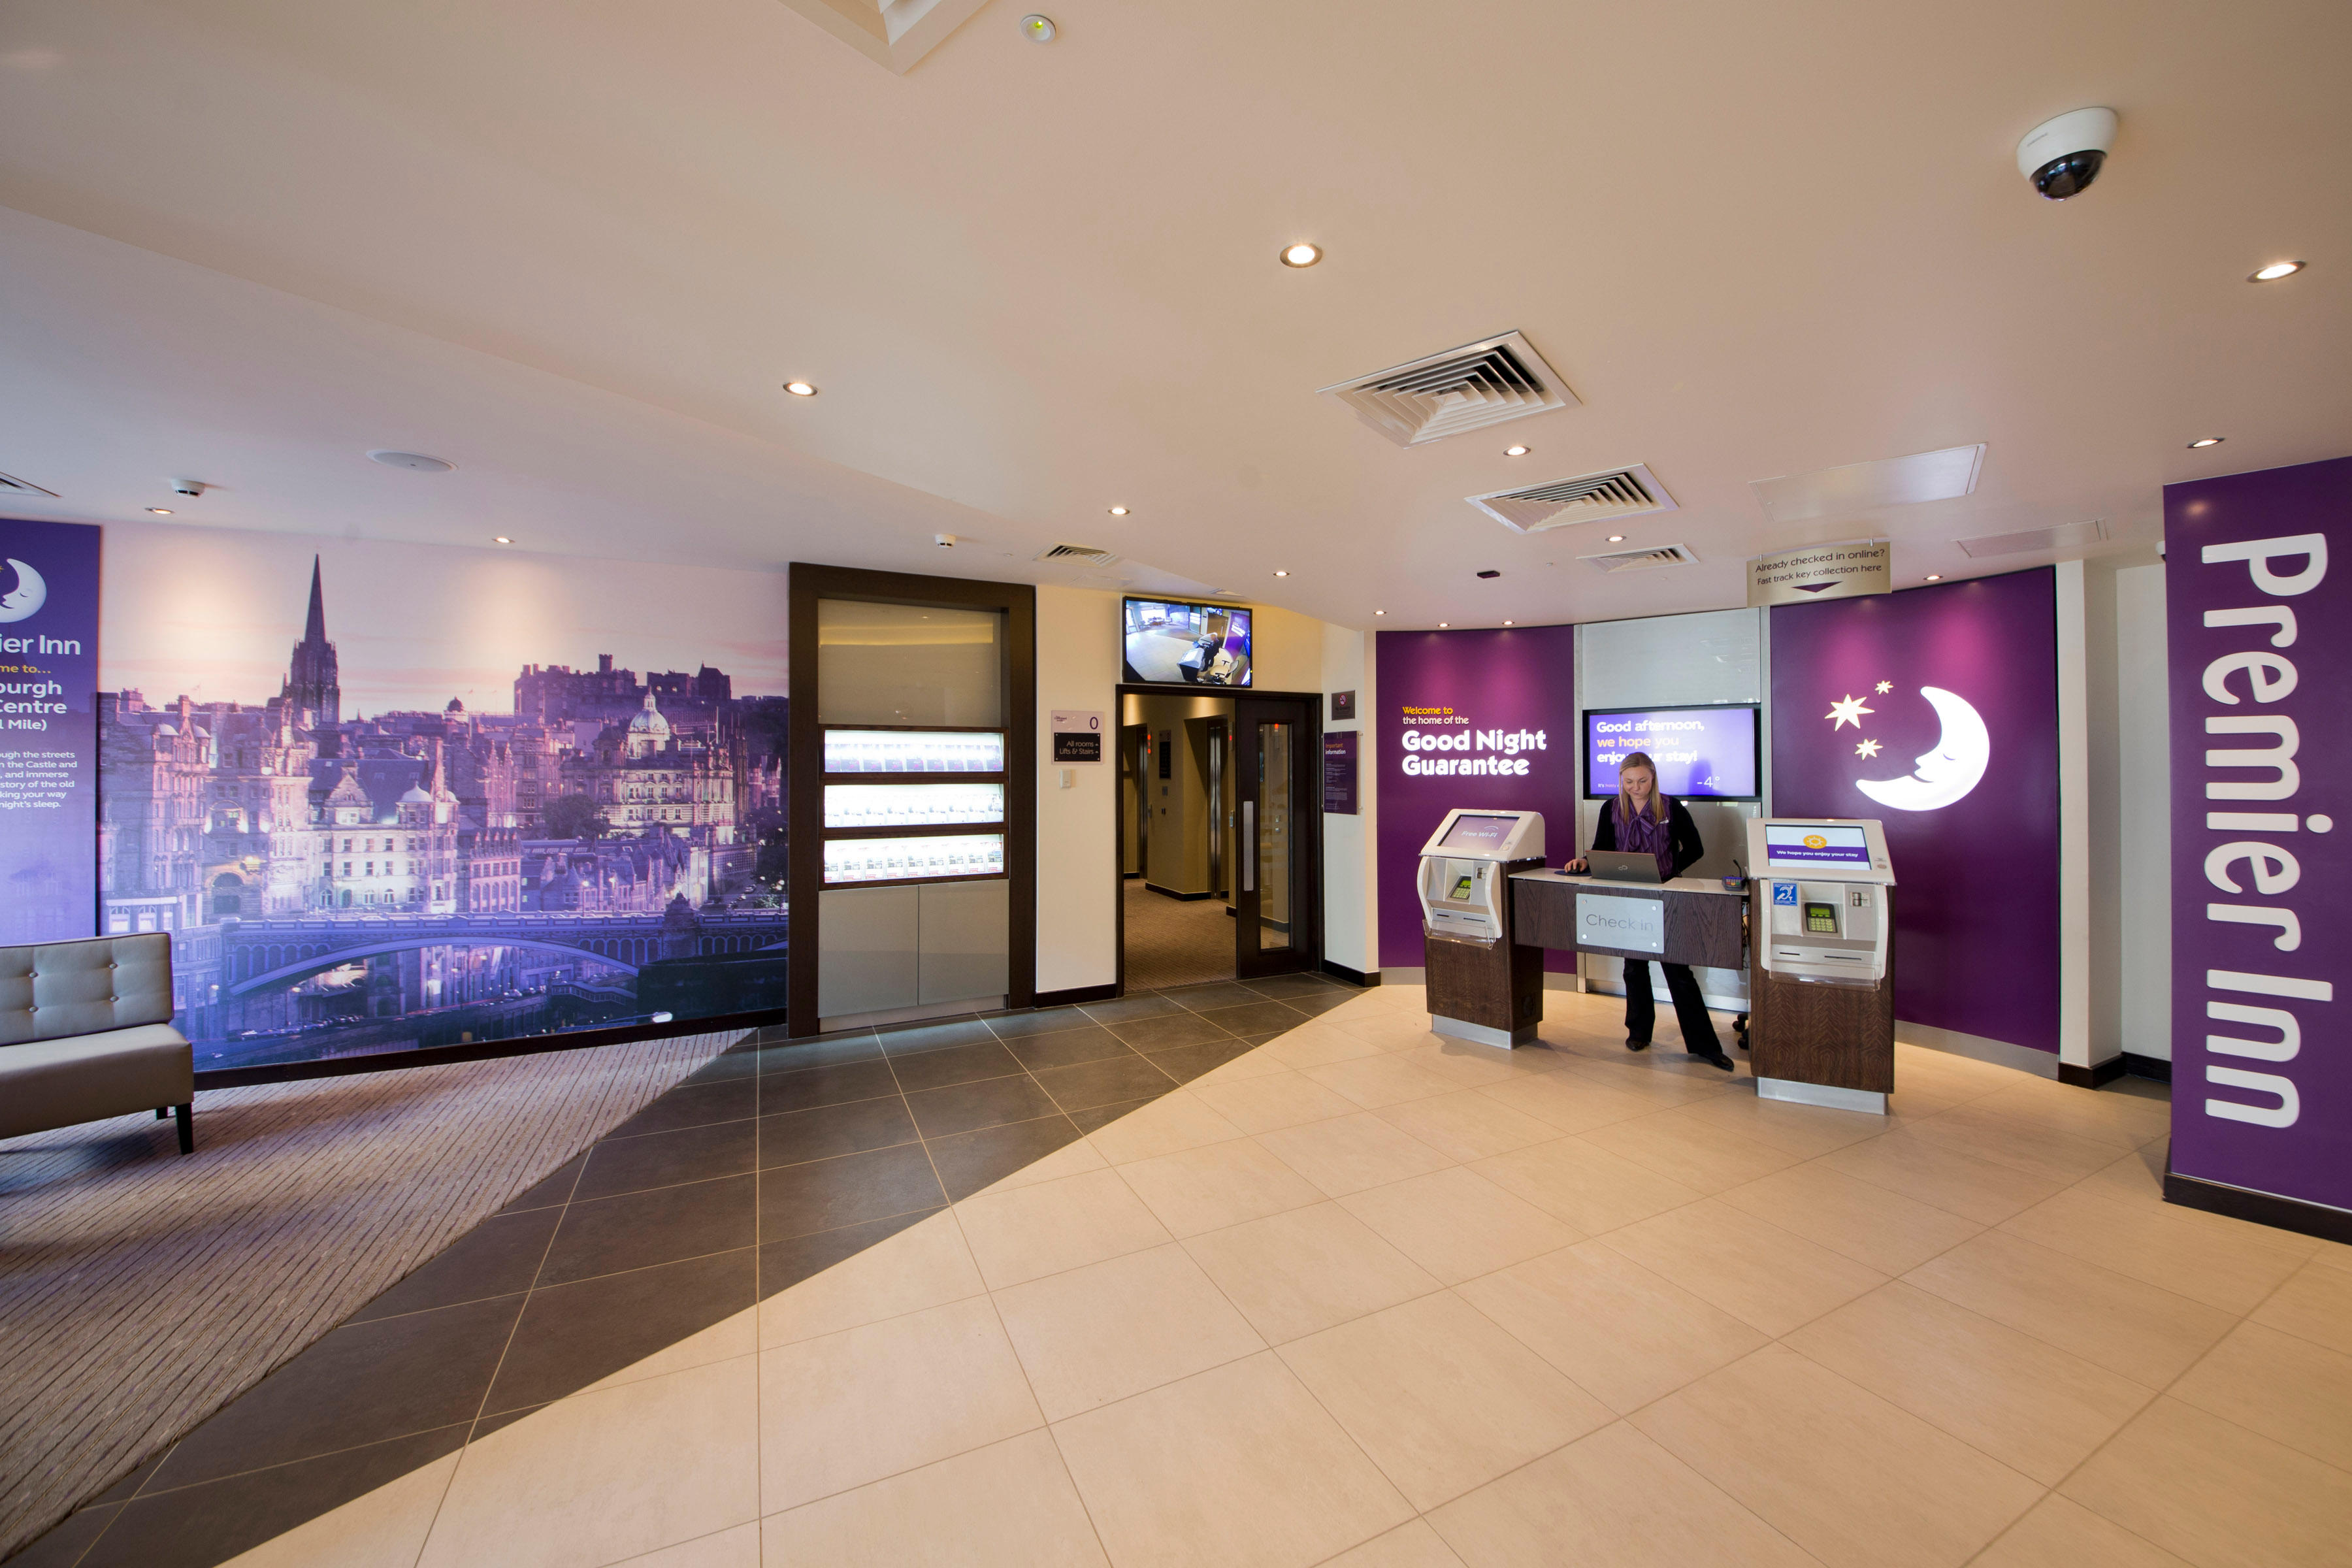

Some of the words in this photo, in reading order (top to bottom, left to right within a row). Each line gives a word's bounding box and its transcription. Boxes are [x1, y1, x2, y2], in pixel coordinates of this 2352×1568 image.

[1755, 561, 1789, 573] Already
[1790, 553, 1833, 566] checked
[1836, 551, 1845, 560] in
[1848, 548, 1886, 560] online?
[1757, 577, 1772, 586] Fast
[1774, 573, 1794, 582] track
[1796, 570, 1811, 579] key
[1813, 566, 1859, 576] collection
[1861, 564, 1882, 572] here
[39, 634, 81, 655] Inn
[22, 664, 52, 674] to...
[0, 699, 67, 714] entre
[1402, 706, 1441, 715] Welcome
[8, 719, 48, 732] Mile)
[1418, 716, 1443, 725] home
[1444, 716, 1454, 725] of
[1455, 716, 1469, 725] the
[1596, 721, 1631, 733] Good
[1635, 720, 1705, 732] afternoon,
[1401, 730, 1470, 751] Good
[1477, 728, 1547, 755] Night
[1597, 738, 1615, 747] we
[1618, 736, 1651, 749] hope
[1655, 737, 1679, 749] you
[2201, 532, 2333, 951] Premier
[0, 751, 21, 760] ugh
[1597, 751, 1629, 765] enjo
[1665, 750, 1698, 765] stay!
[1401, 755, 1530, 776] Guarantee
[33, 801, 61, 809] sleep.
[1586, 913, 1636, 930] Check
[2205, 969, 2333, 1128] Inn
